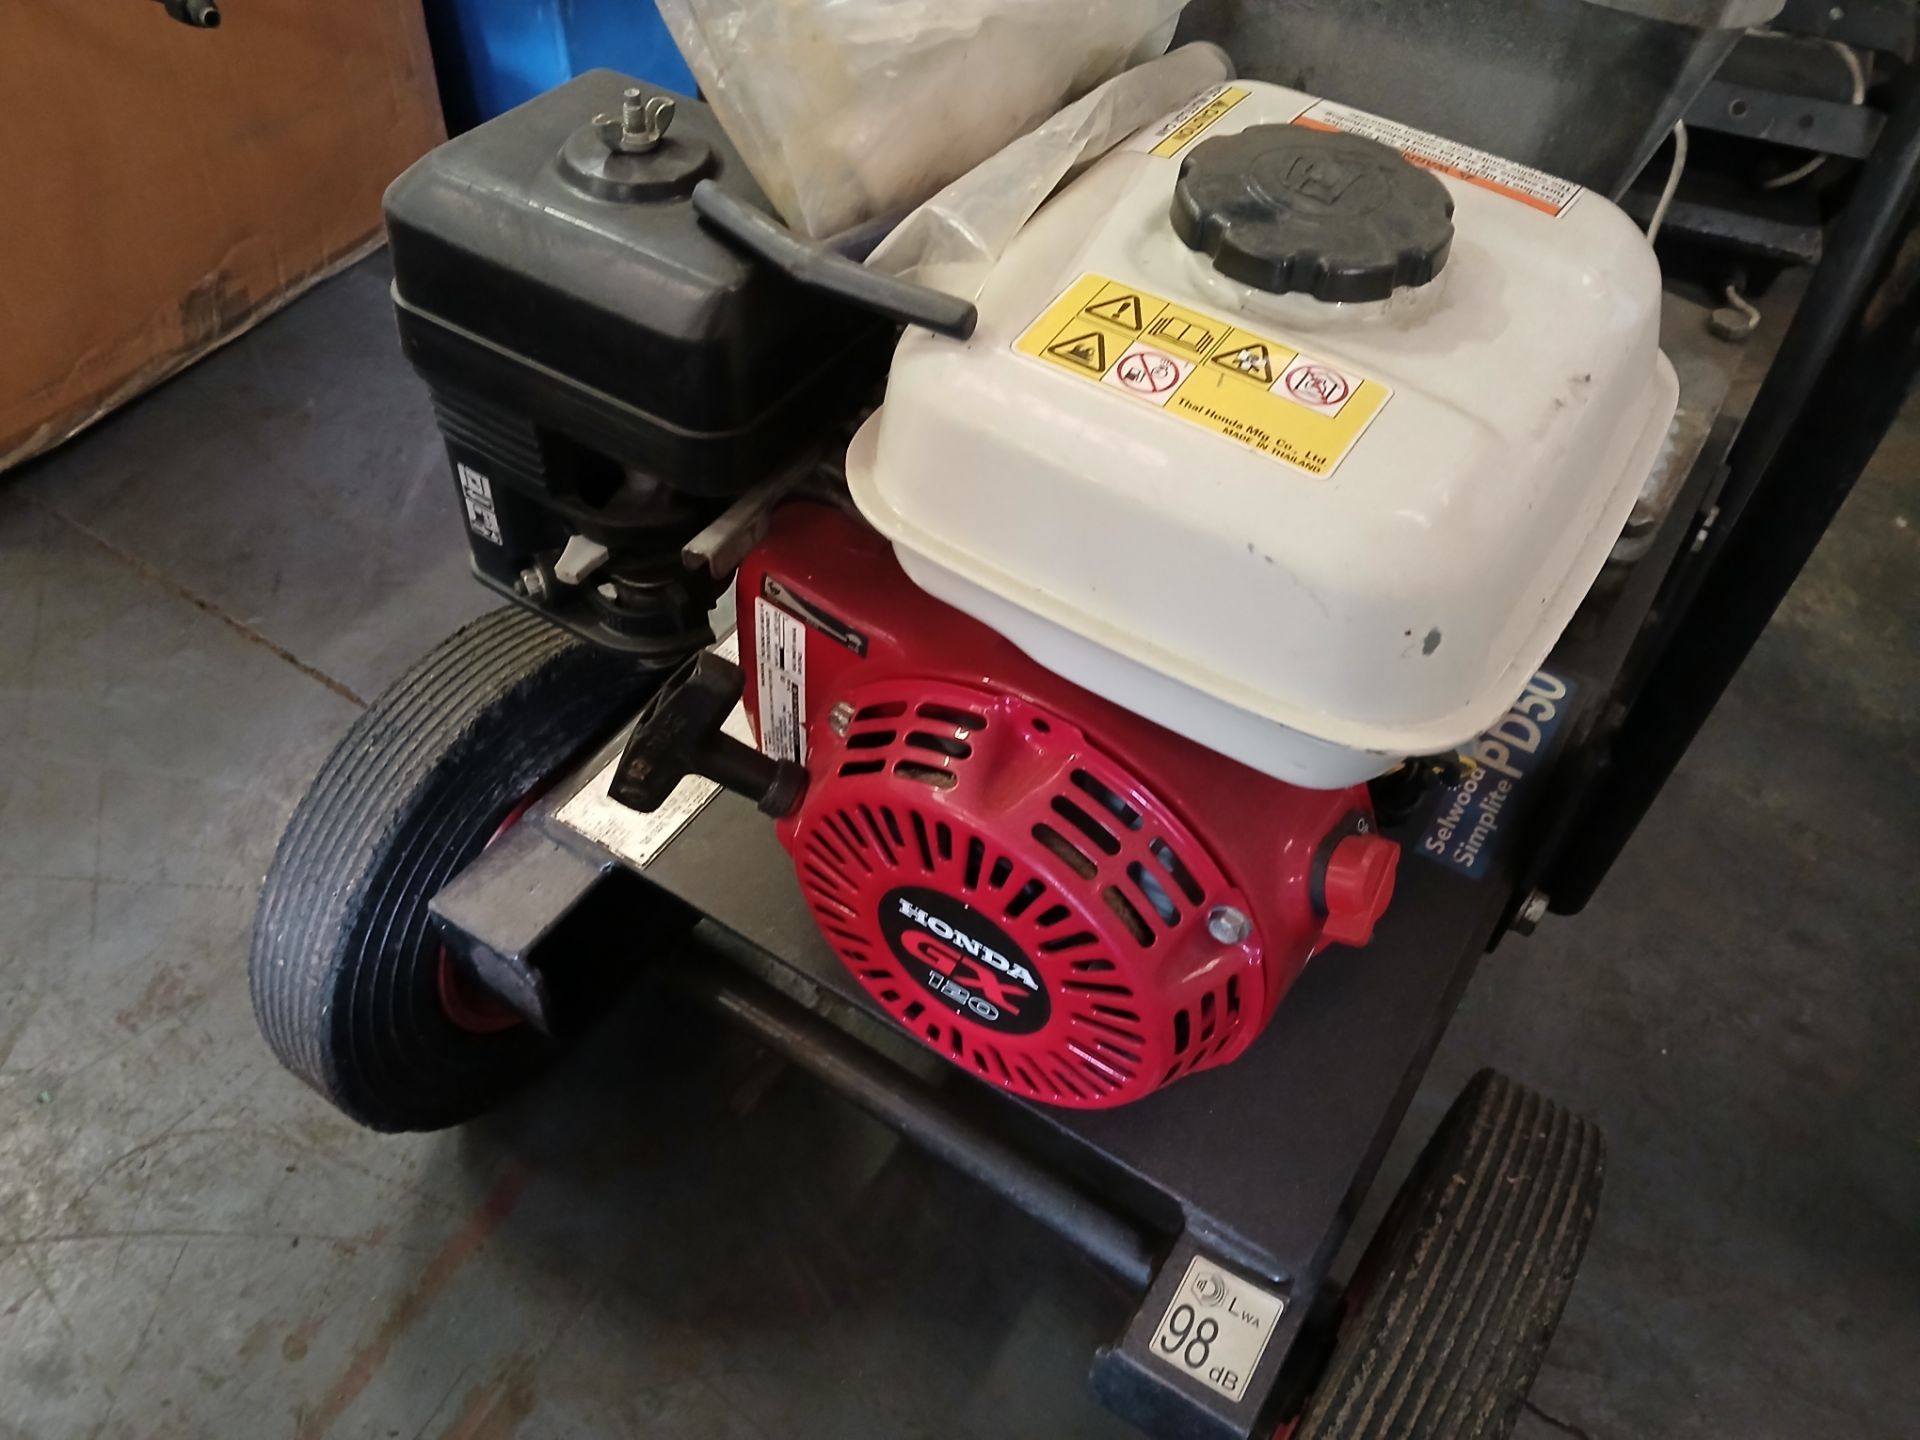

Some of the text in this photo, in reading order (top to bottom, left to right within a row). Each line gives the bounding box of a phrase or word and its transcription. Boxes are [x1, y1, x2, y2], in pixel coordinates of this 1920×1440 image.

[1178, 397, 1204, 414] Thai
[1205, 408, 1242, 431] Honda
[1222, 427, 1321, 473] MADE IN THAILAND
[1475, 670, 1568, 780] PD50
[1425, 766, 1487, 855] Selwood
[1453, 778, 1513, 868] Simplite
[898, 897, 1039, 992] HONDA
[901, 930, 1031, 1017] GX
[928, 969, 1000, 1021] 120
[1160, 1304, 1220, 1369] 98
[1208, 1366, 1239, 1391] dB
